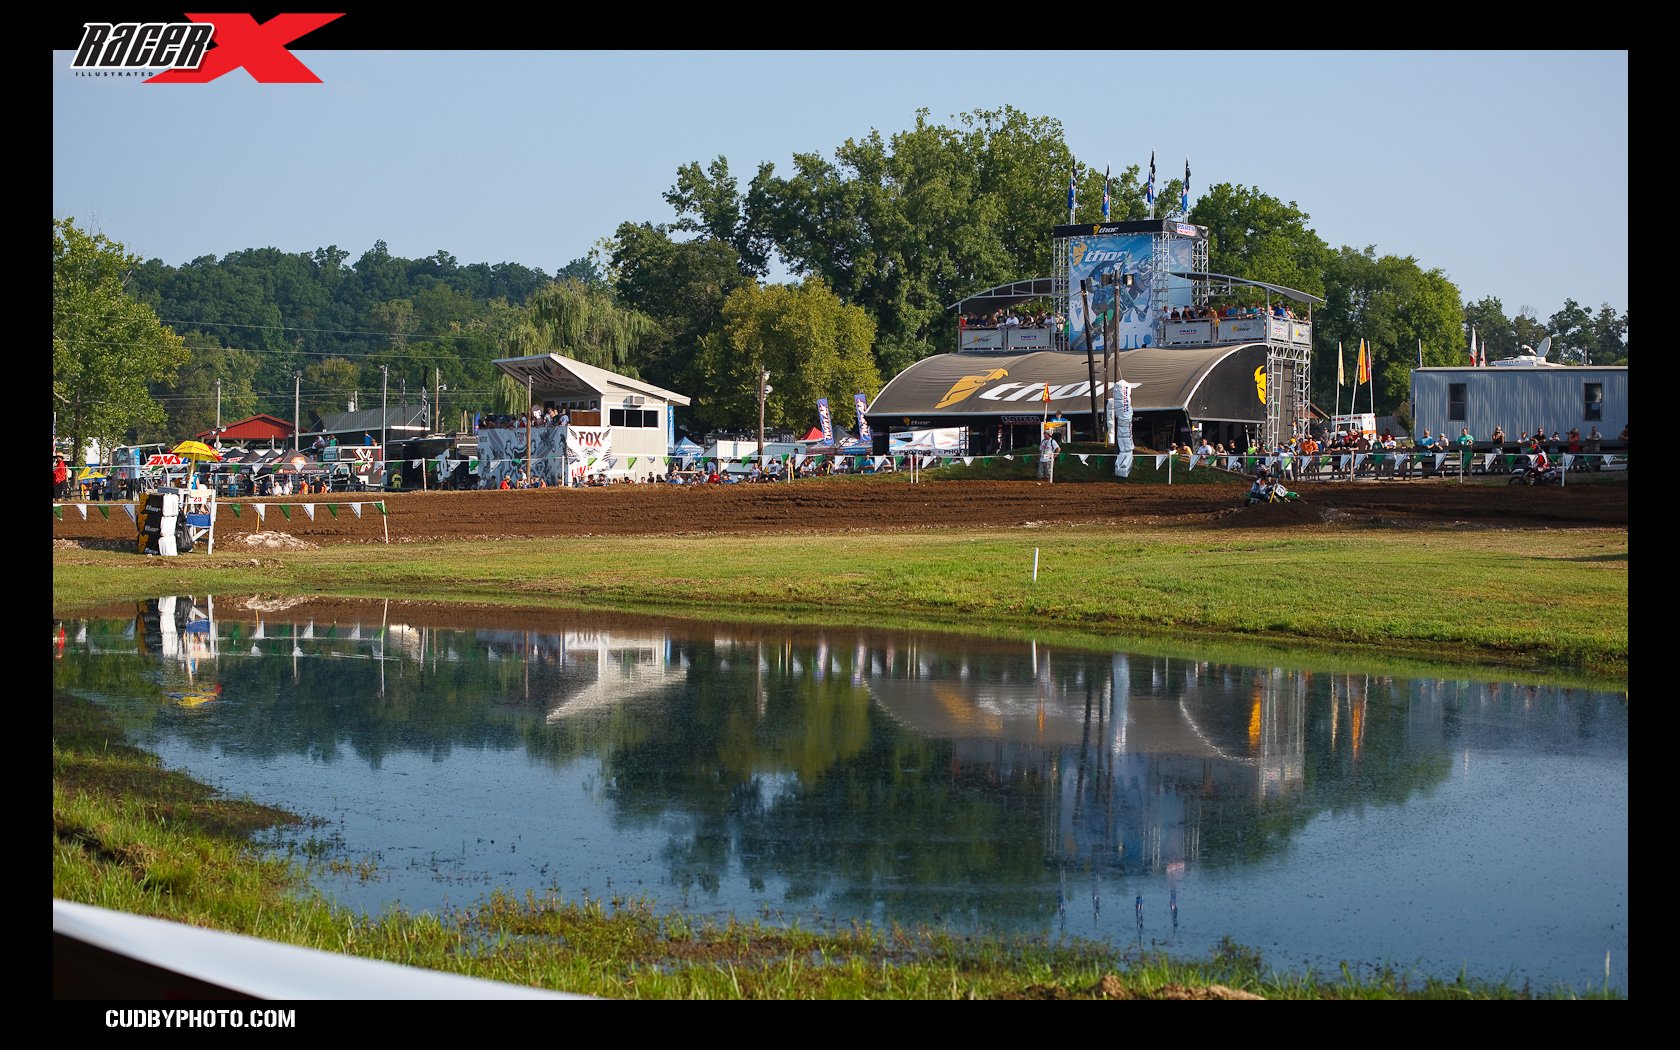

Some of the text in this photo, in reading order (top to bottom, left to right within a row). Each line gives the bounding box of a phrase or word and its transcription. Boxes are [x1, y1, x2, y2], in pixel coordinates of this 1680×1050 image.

[1085, 250, 1128, 262] thor
[979, 380, 1142, 402] thor
[579, 431, 602, 446] FOX
